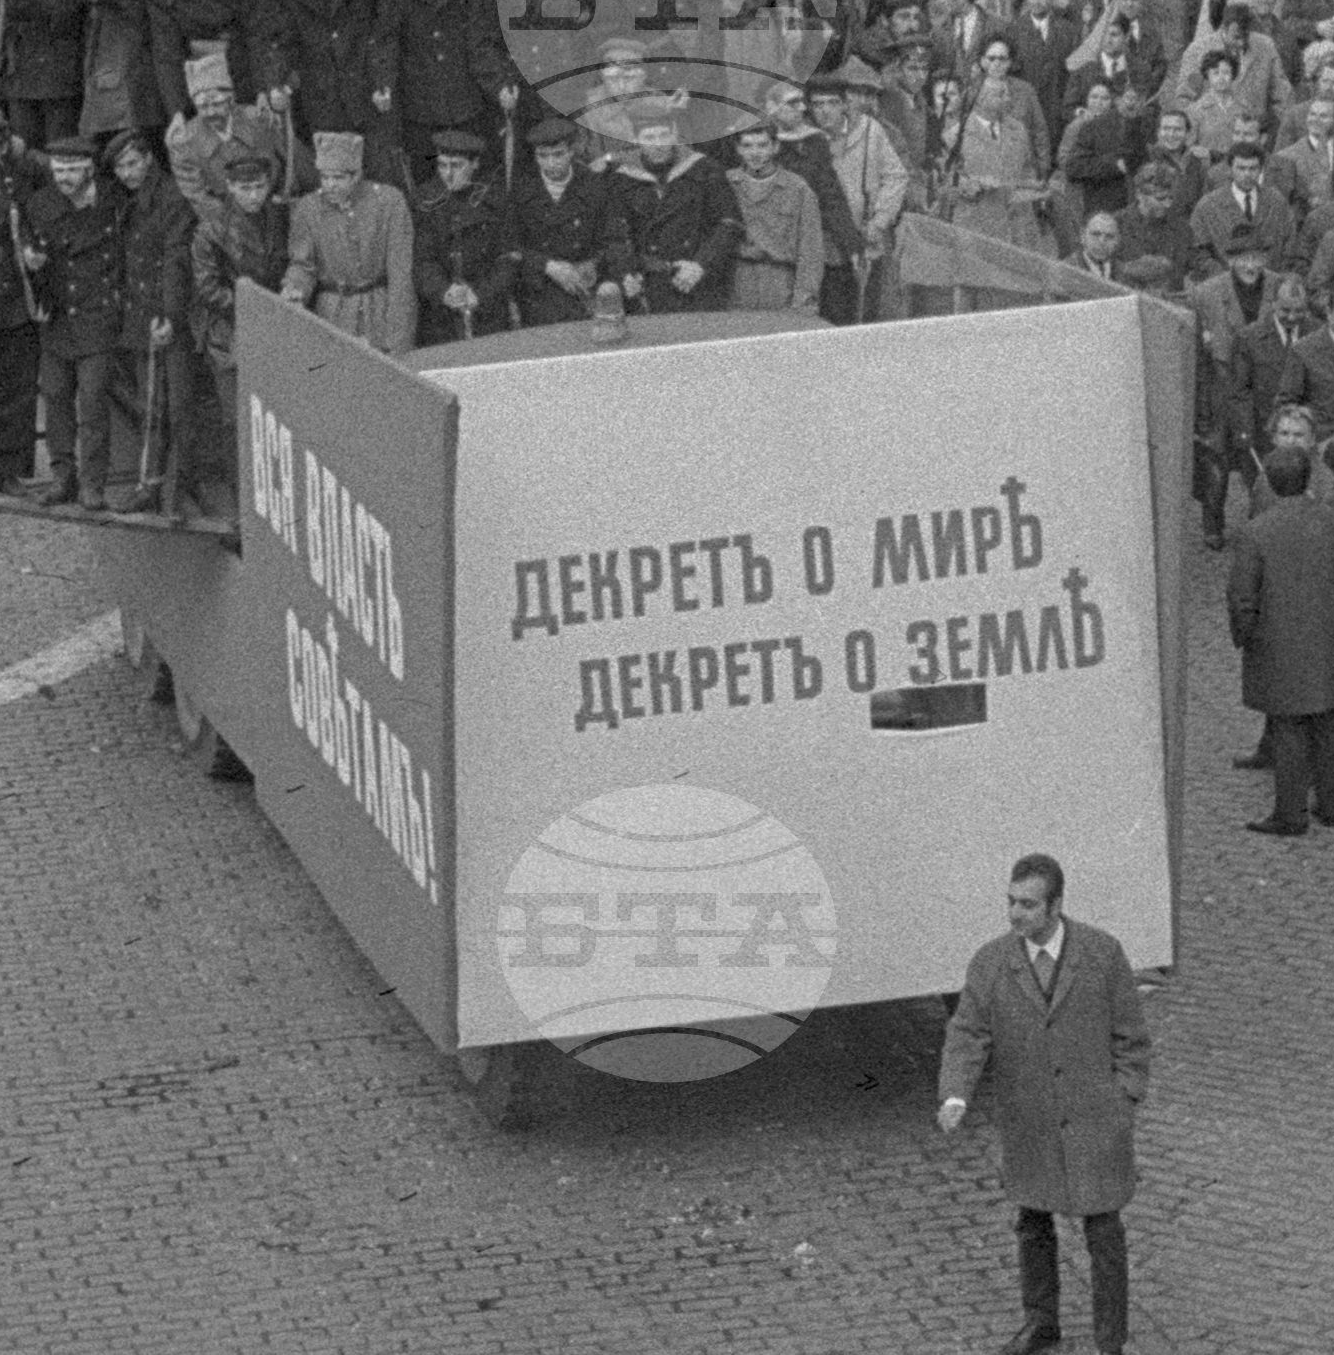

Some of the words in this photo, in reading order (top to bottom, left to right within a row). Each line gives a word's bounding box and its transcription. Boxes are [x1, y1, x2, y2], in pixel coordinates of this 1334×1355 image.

[250, 393, 297, 555] ВСЯ
[511, 533, 774, 641] ДЕКРЕТЪ
[802, 524, 836, 597] О
[574, 635, 824, 733] ДЕКРЕТЪ
[844, 628, 878, 694] О
